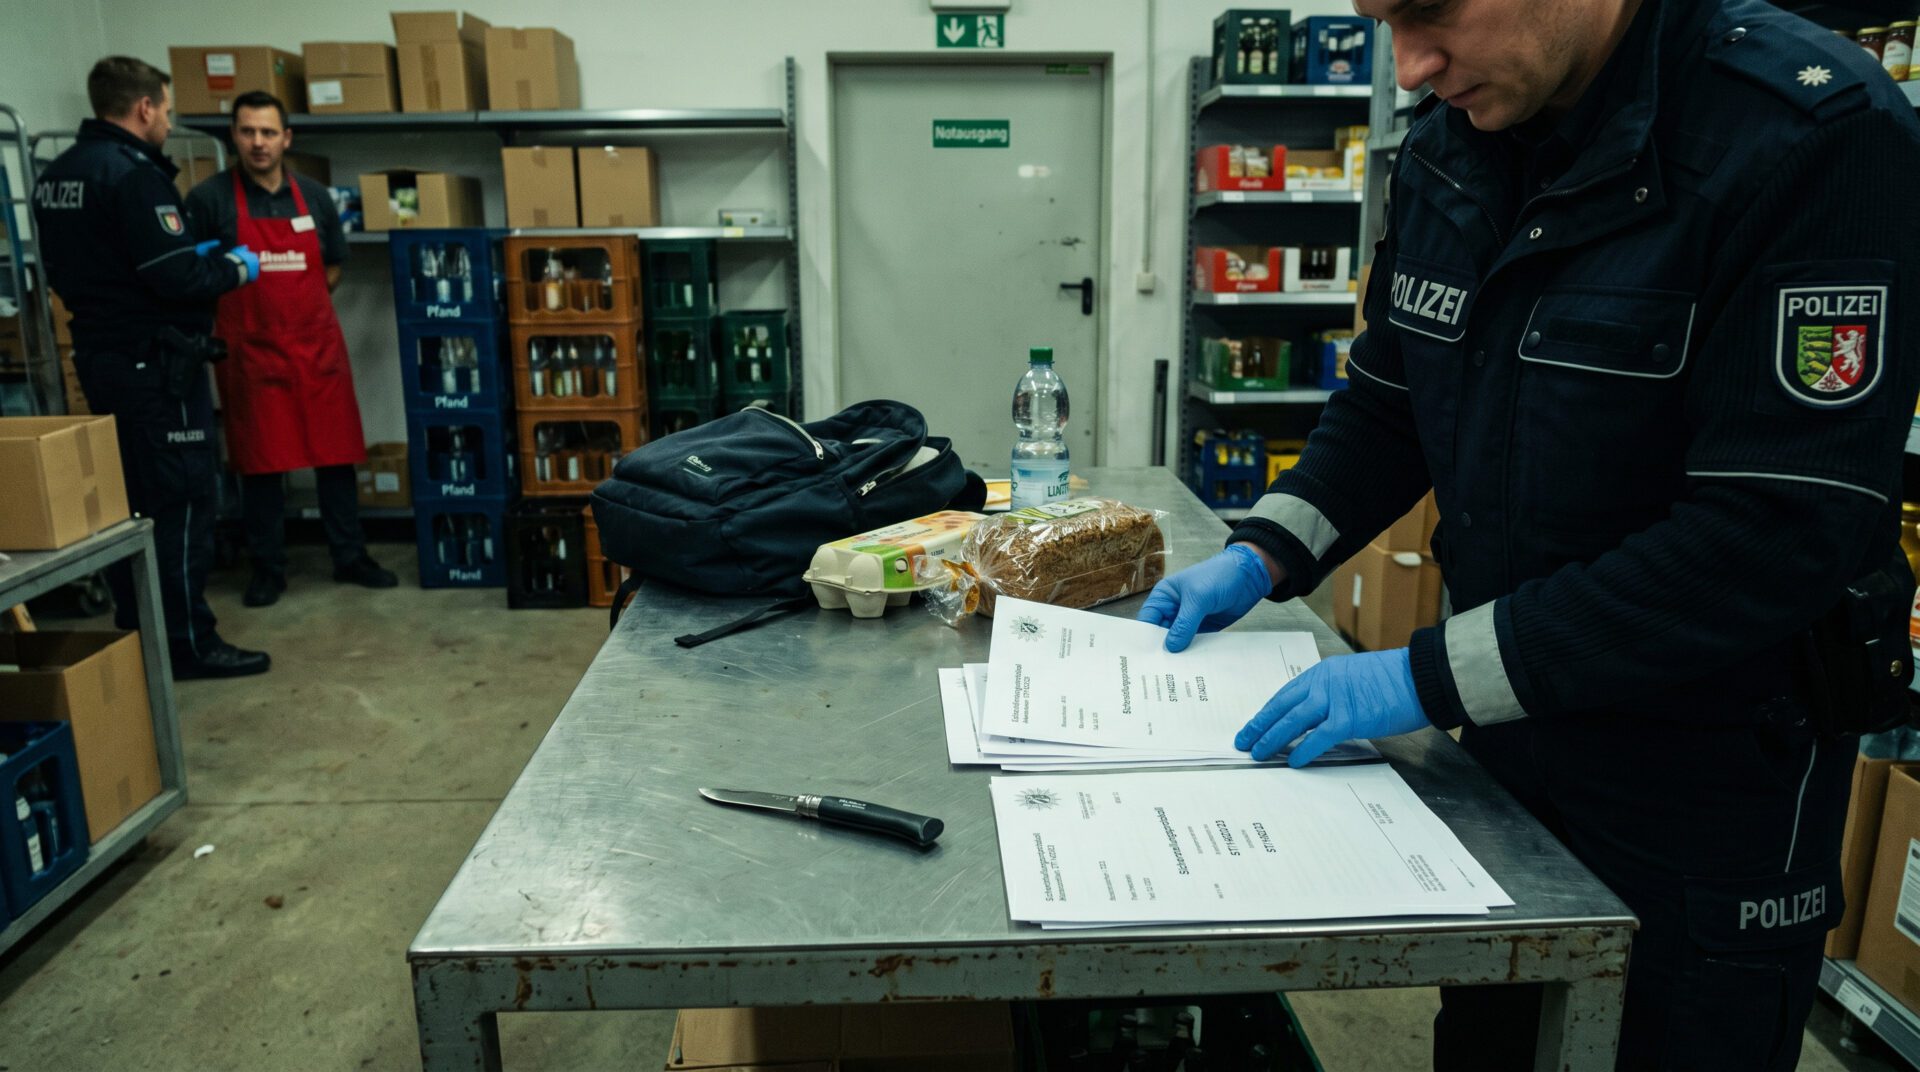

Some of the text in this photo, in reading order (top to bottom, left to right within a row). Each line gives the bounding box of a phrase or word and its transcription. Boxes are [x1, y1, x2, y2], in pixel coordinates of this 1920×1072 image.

[934, 125, 1008, 143] Notausgang
[1390, 271, 1468, 325] POLIZEI
[426, 304, 462, 318] Pfand
[1788, 295, 1878, 317] POLIZEI
[434, 395, 469, 408] Pfand
[167, 430, 205, 443] POLIZEI
[441, 484, 475, 496] Pfand
[449, 569, 482, 581] Pfand
[1739, 885, 1826, 930] POLIZEI
